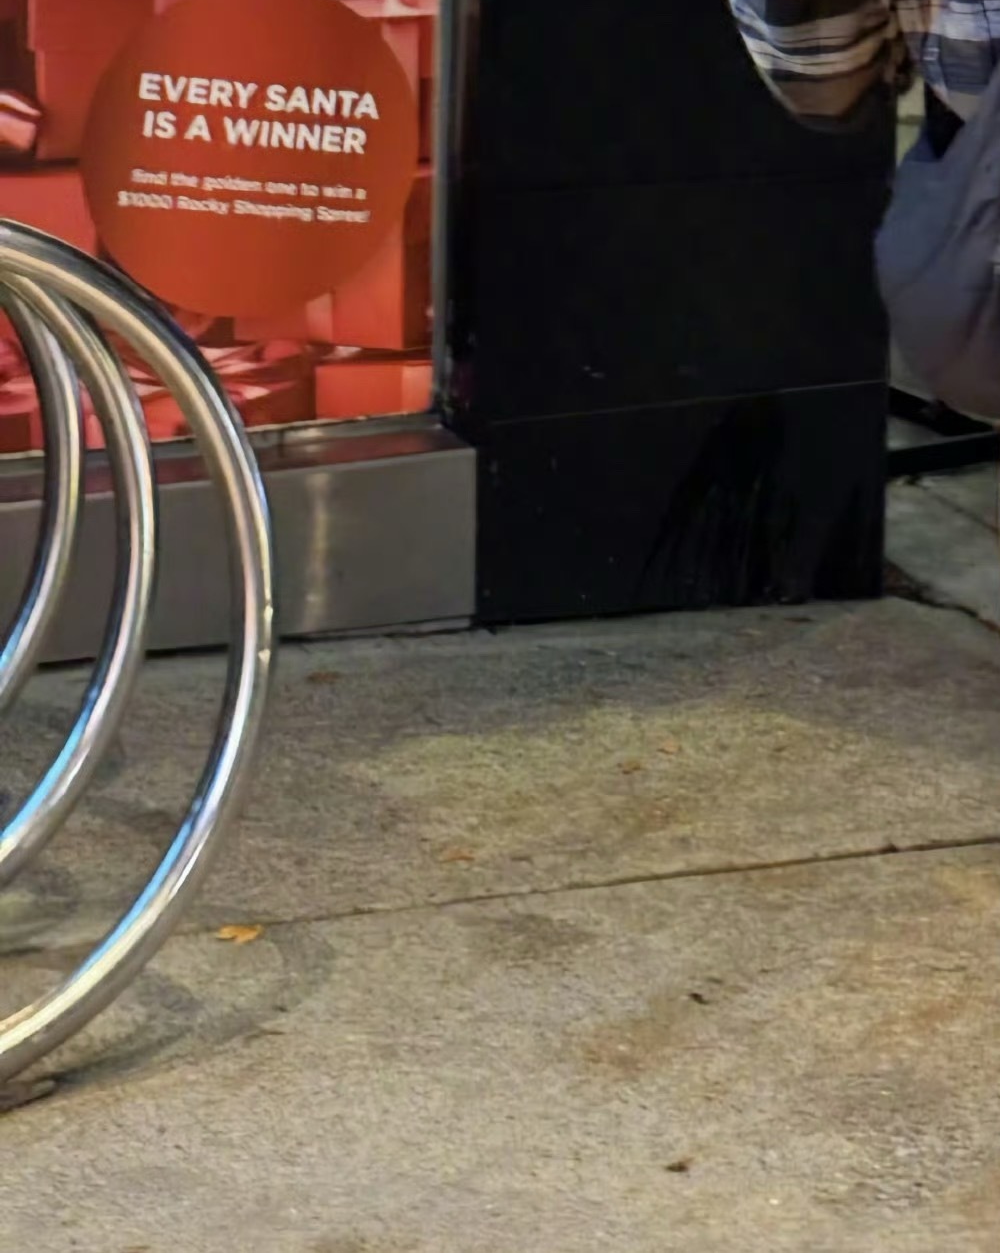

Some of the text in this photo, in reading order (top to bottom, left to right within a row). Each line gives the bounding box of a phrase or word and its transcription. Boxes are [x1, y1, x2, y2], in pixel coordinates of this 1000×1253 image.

[138, 72, 379, 120] EVERY SANTA
[142, 110, 368, 155] IS A WINNER
